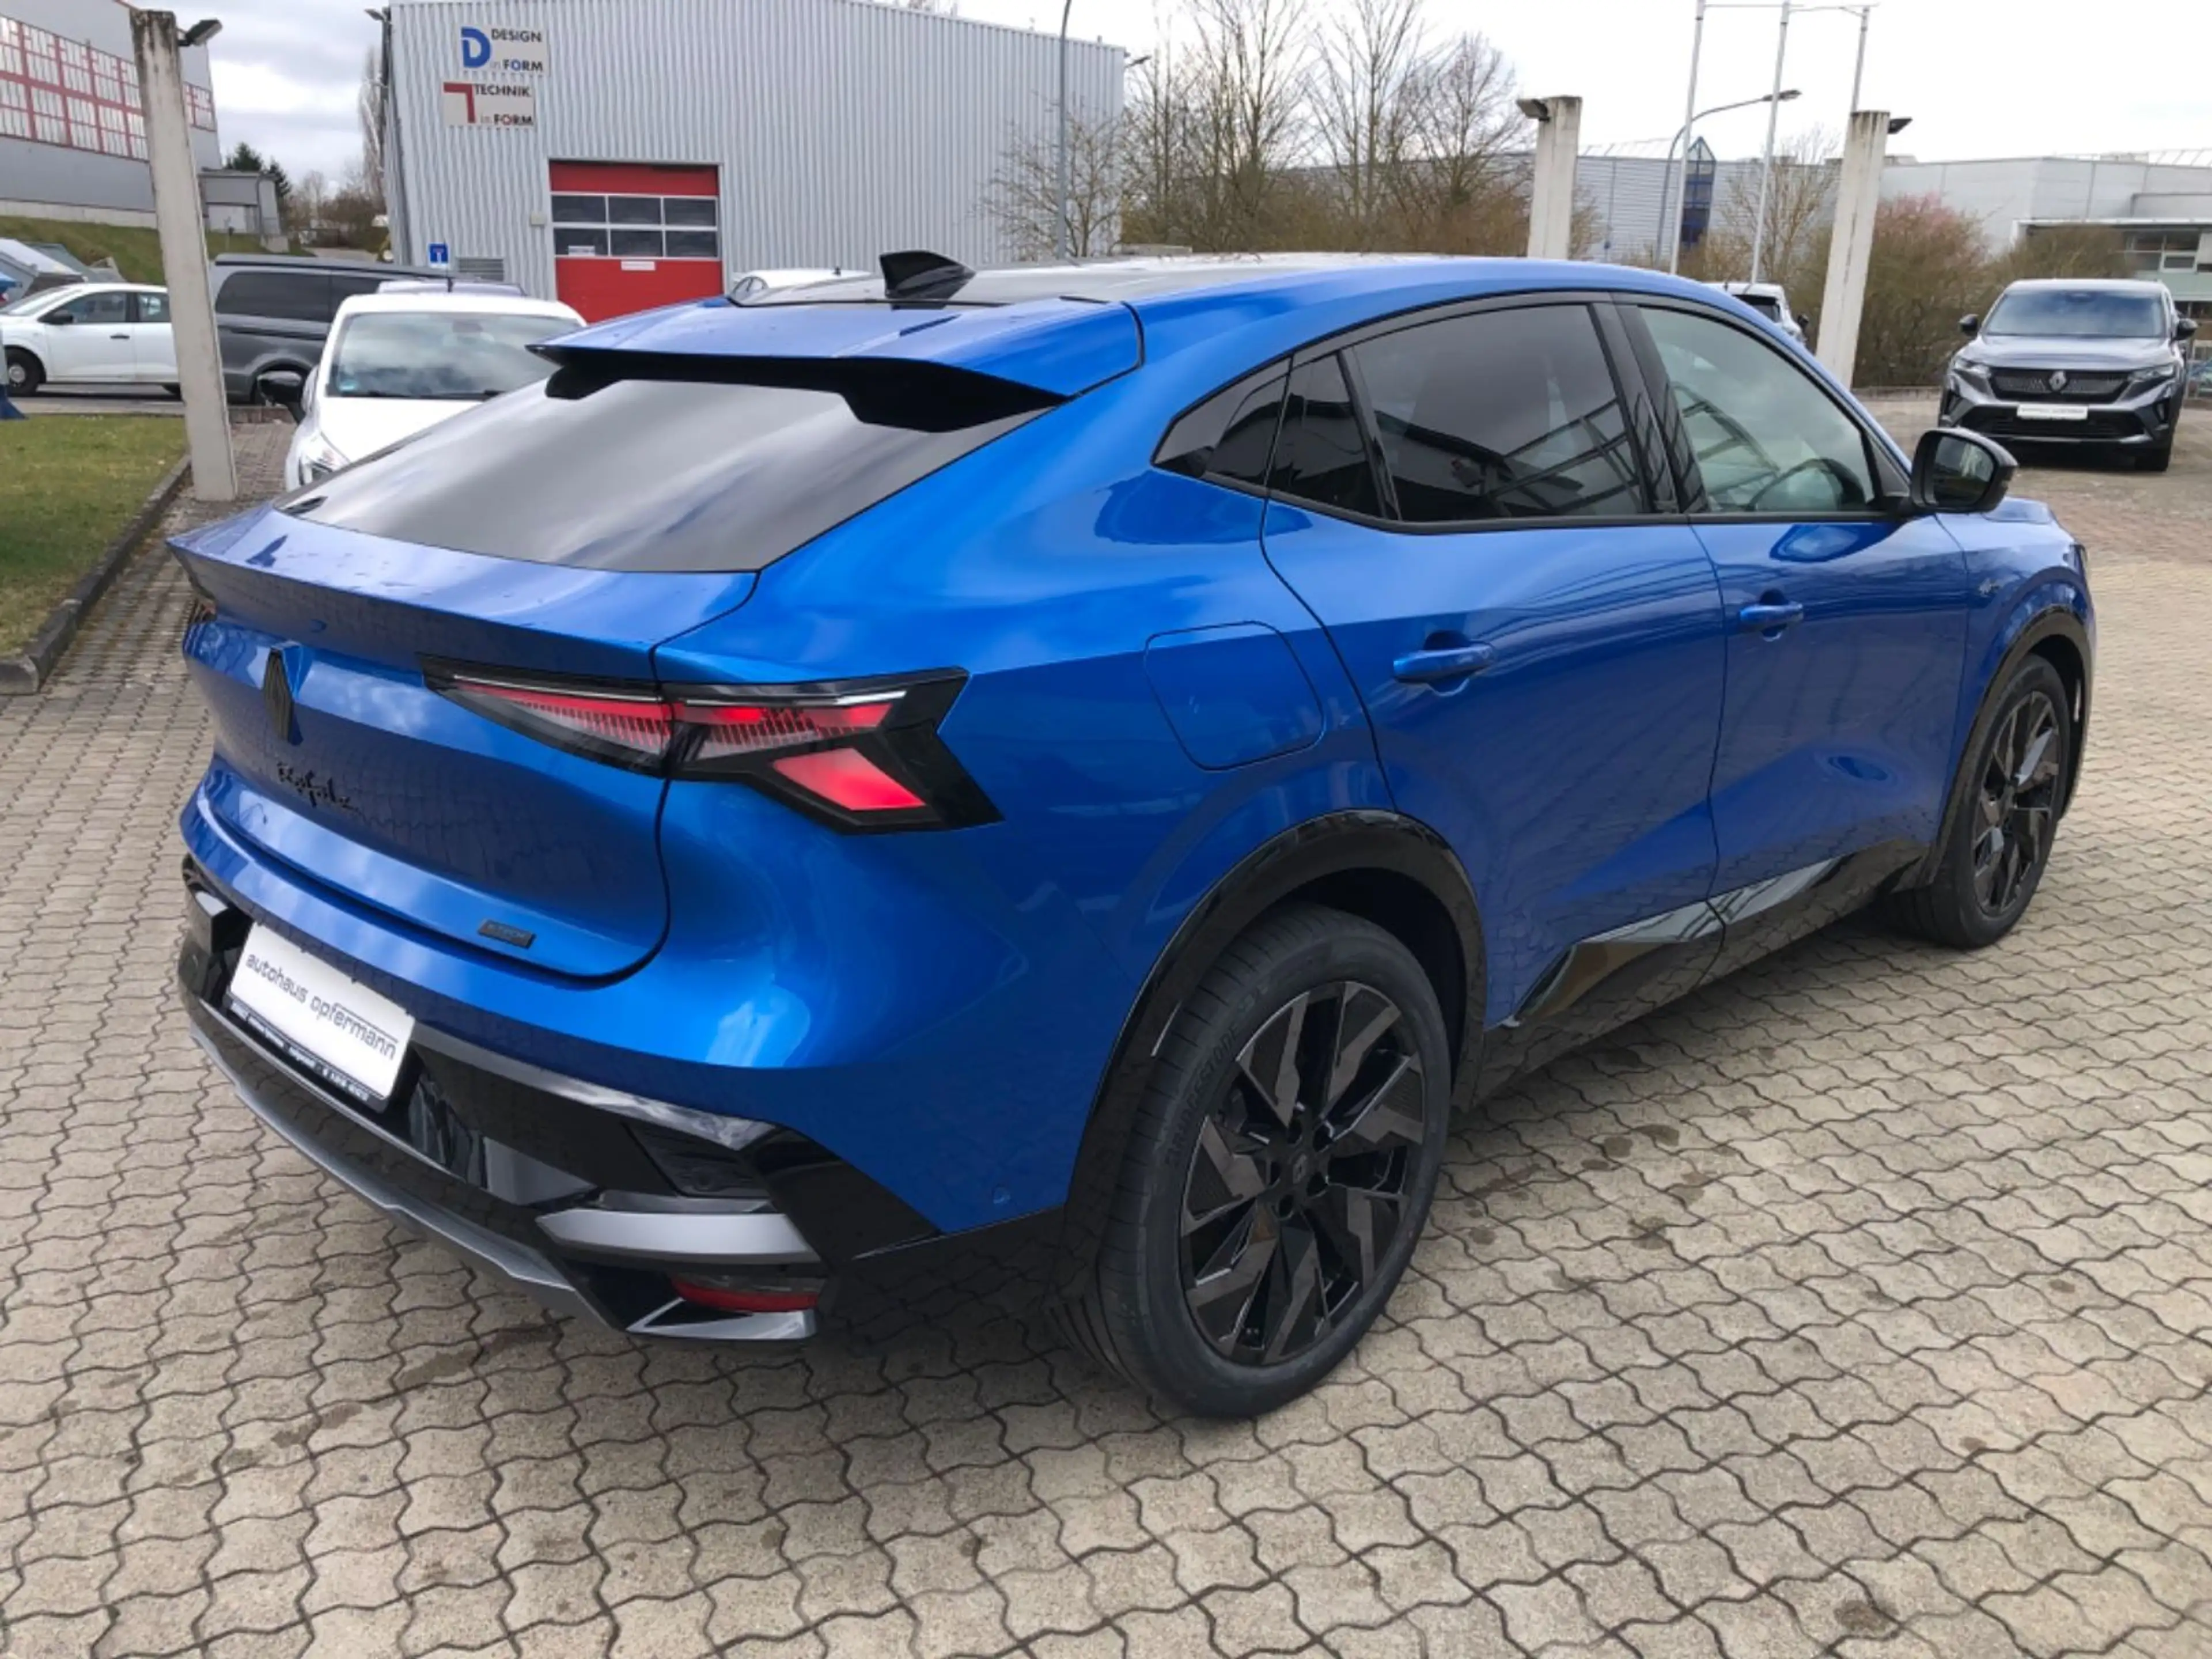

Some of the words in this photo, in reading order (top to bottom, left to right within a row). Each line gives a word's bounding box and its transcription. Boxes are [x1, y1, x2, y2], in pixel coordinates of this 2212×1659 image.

[491, 28, 542, 42] DESIGN
[503, 59, 543, 71] FORM
[475, 84, 531, 97] TECHNIK
[494, 113, 533, 126] FORM
[245, 953, 309, 1003] autohaus
[310, 996, 399, 1060] opfermann
